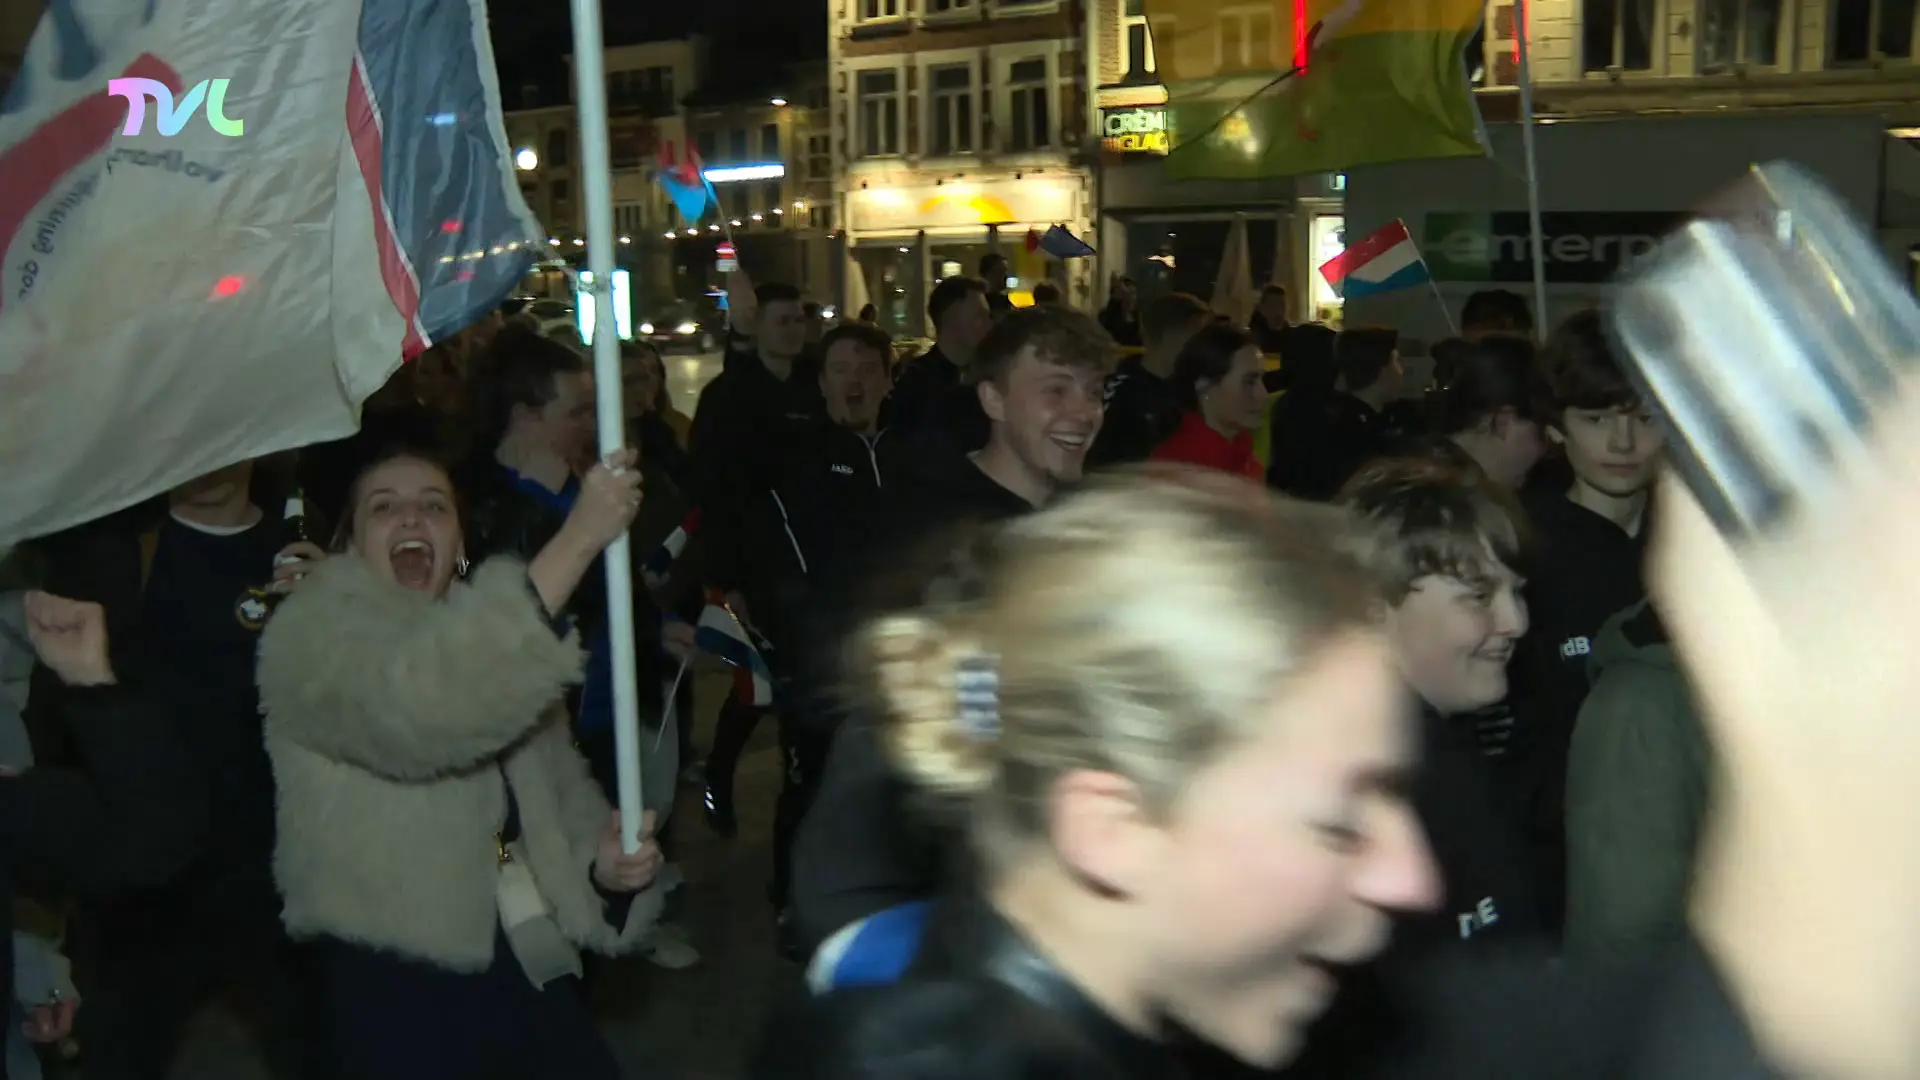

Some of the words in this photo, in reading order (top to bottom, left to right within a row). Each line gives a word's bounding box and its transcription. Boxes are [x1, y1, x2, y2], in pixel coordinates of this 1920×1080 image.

[1104, 108, 1167, 135] CRÈM
[1119, 131, 1169, 154] GLAC
[1441, 228, 1656, 277] enterp
